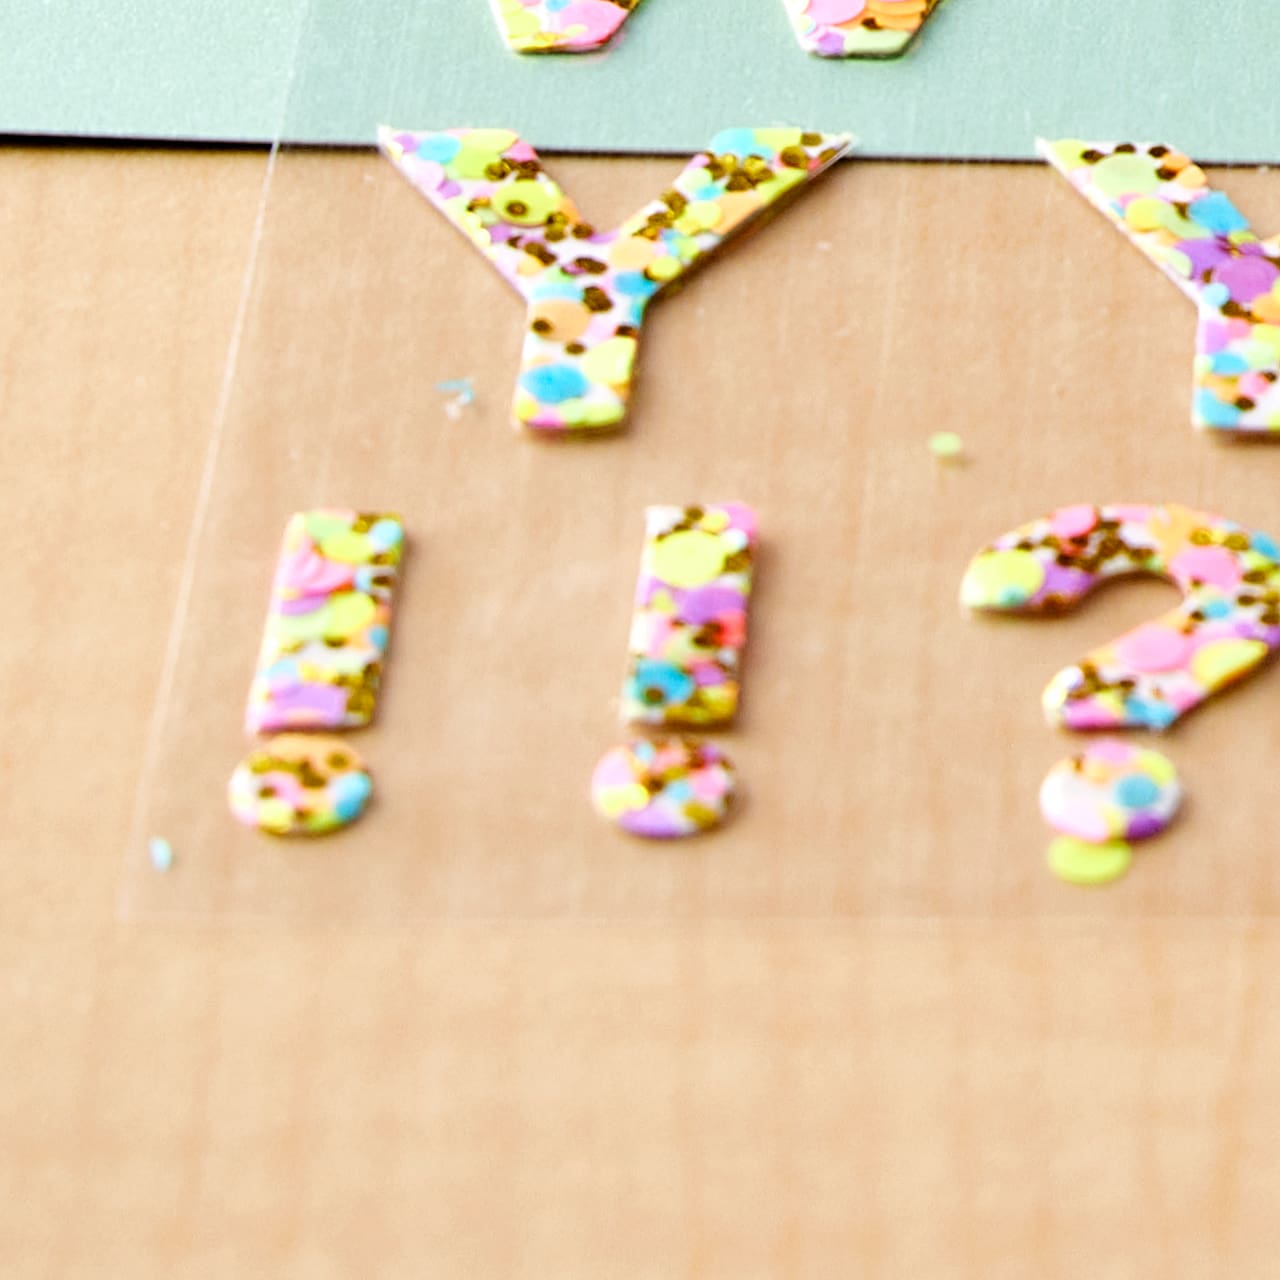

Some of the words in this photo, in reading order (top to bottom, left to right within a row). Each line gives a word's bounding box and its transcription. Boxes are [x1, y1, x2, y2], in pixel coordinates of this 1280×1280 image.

[377, 125, 855, 433] Y
[228, 508, 403, 837] !
[592, 502, 758, 840] !
